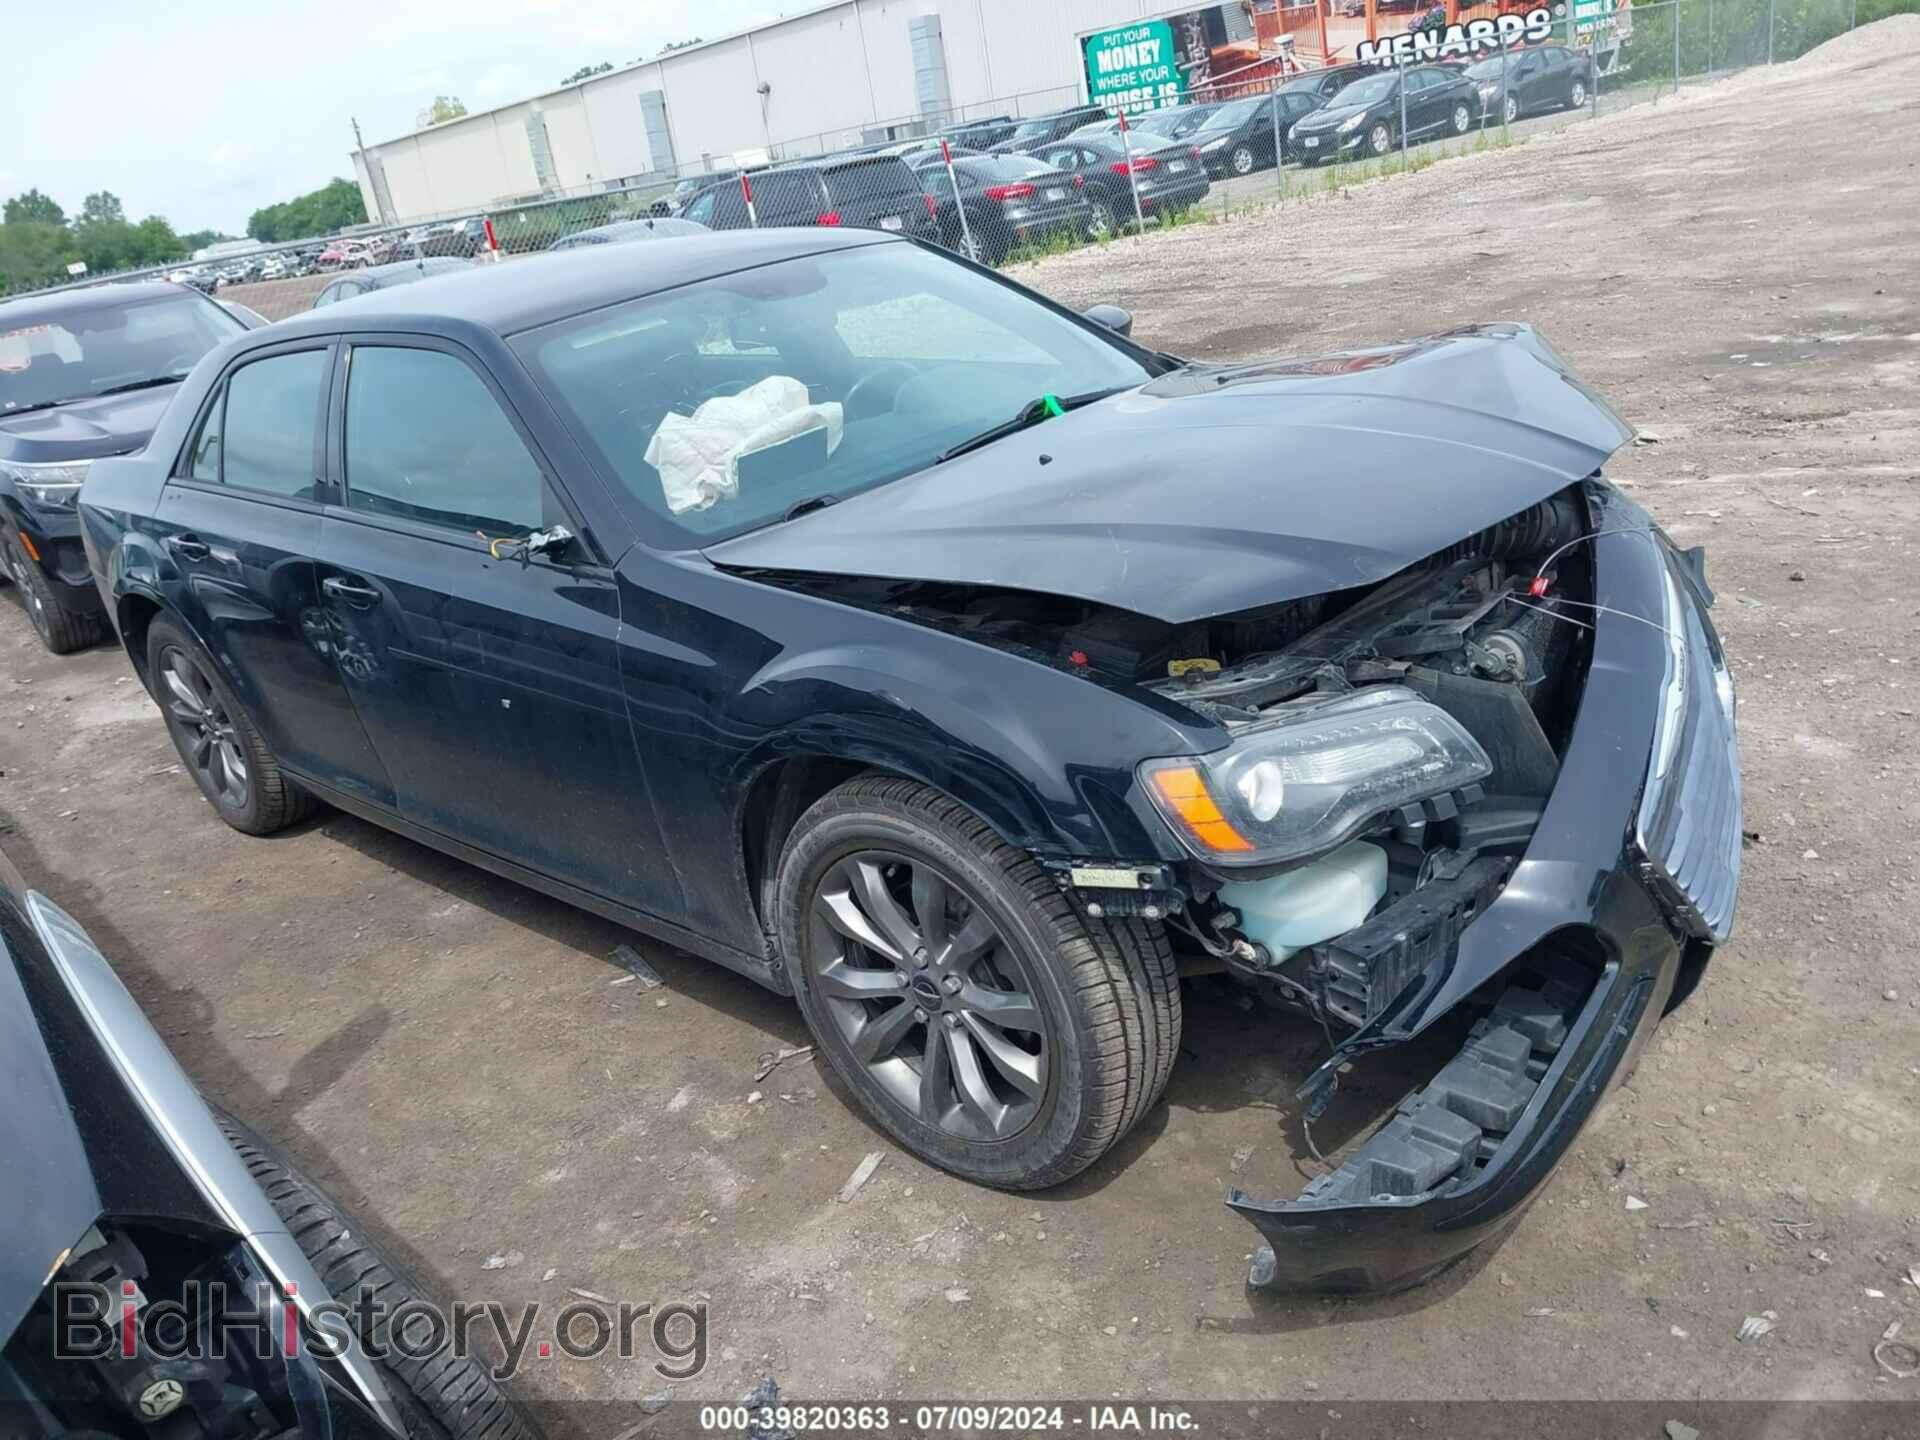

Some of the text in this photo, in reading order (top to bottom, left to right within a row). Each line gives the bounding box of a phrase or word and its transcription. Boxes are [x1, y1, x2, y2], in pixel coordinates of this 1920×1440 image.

[1103, 27, 1151, 47] PUT YOUR
[1357, 7, 1553, 68] MENARDS
[1096, 38, 1161, 74] MONEY
[1096, 65, 1169, 90] WHERE YOUR
